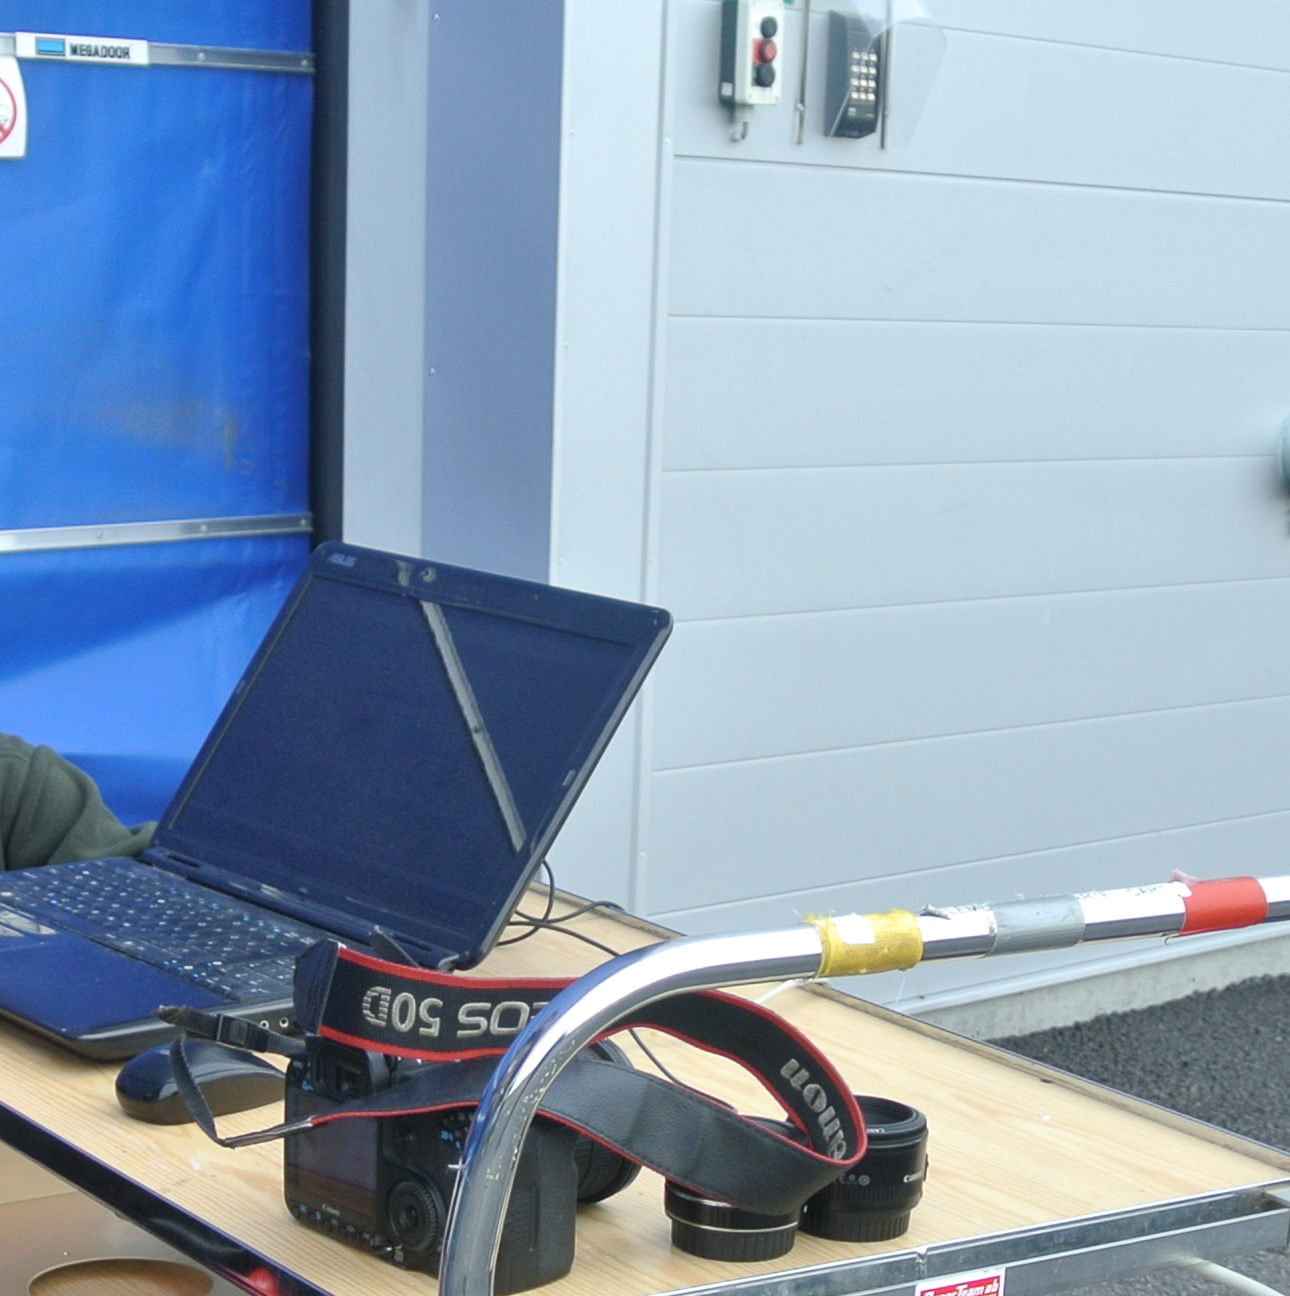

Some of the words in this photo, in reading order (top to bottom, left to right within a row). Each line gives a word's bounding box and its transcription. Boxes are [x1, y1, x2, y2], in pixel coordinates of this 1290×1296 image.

[70, 44, 130, 58] MEGADOOR
[362, 986, 443, 1037] 50D
[780, 1058, 847, 1161] anon
